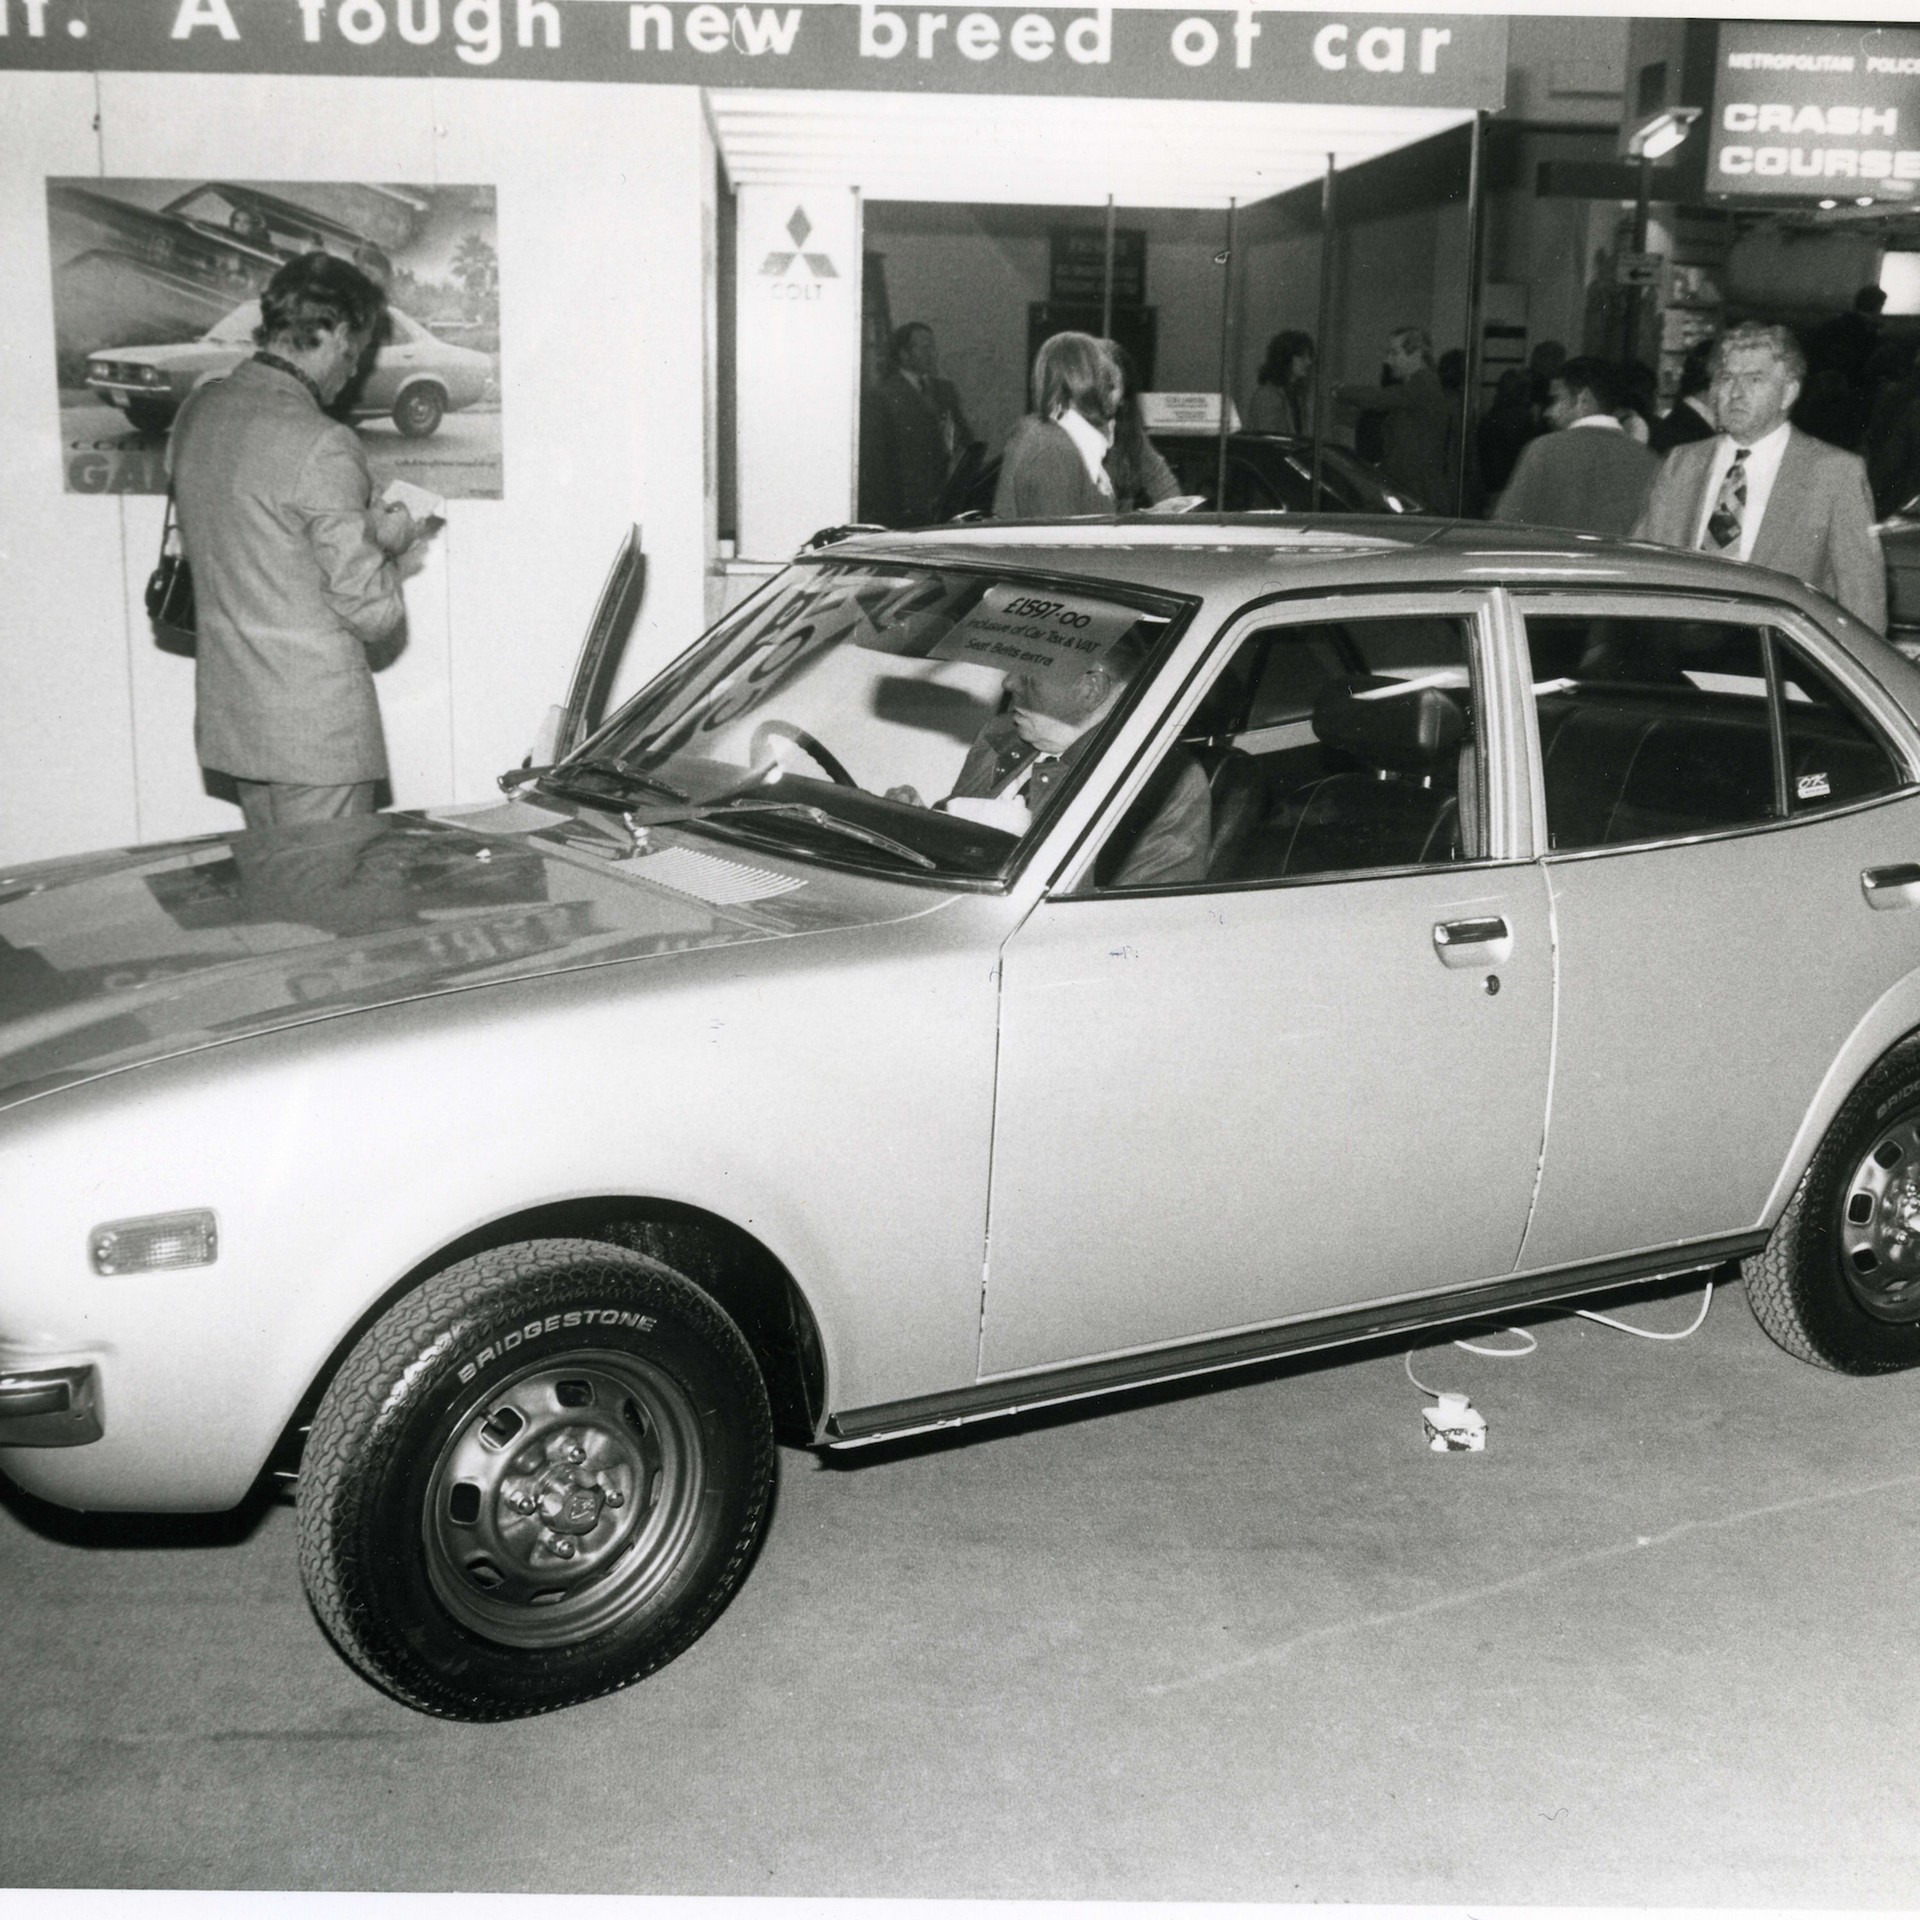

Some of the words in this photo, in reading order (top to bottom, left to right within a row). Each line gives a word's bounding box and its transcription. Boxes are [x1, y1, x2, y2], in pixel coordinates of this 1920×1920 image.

[171, 0, 242, 40] A
[298, 0, 561, 66] tough
[629, 4, 803, 55] new
[860, 4, 1112, 64] breed
[1171, 10, 1261, 68] of
[1313, 23, 1452, 73] car
[1728, 53, 1855, 71] METROPOLITAN
[1723, 103, 1898, 135] CRASH
[1719, 146, 1920, 179] COURSE
[771, 283, 823, 300] COLT
[1024, 626, 1046, 639] Car
[1075, 638, 1102, 653] VAT
[1020, 651, 1054, 666] extra
[457, 1310, 657, 1384] BRIDGESTONE
